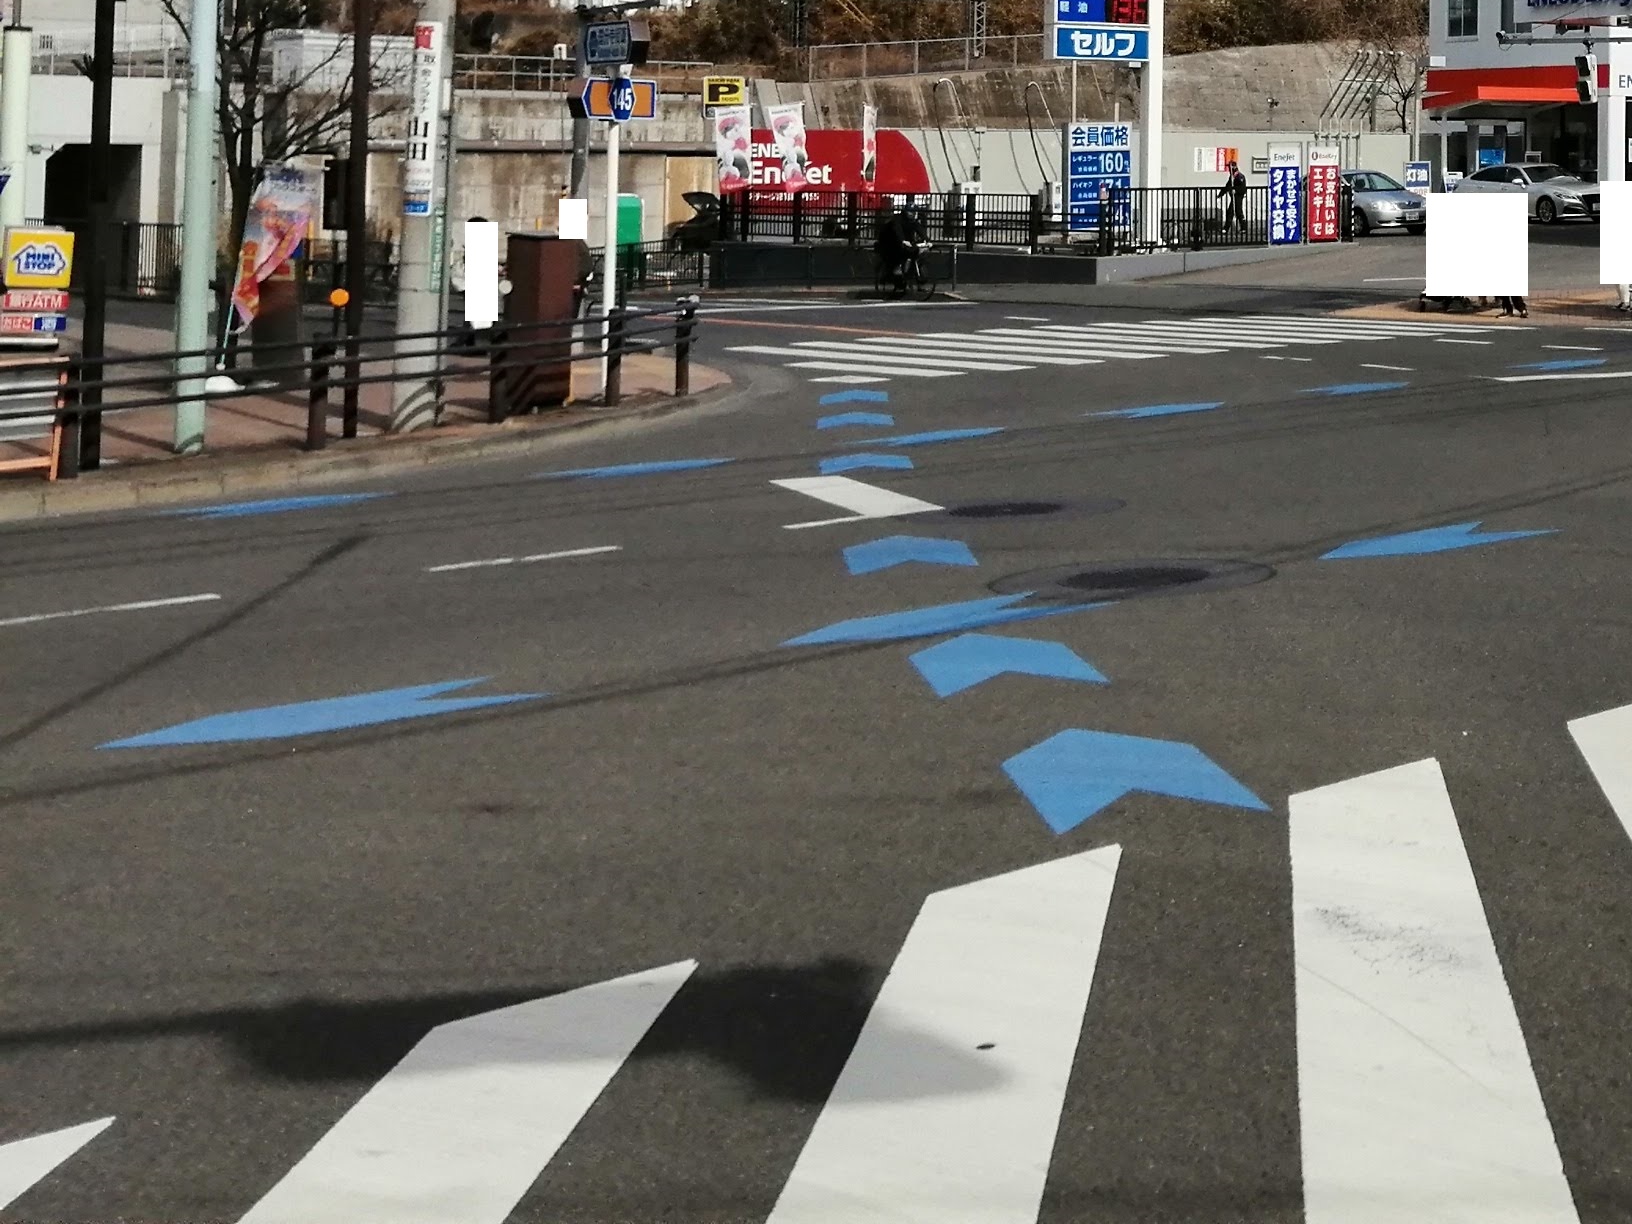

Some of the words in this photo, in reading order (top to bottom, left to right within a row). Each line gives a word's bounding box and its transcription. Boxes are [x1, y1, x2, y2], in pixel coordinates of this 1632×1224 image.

[1070, 30, 1136, 57] セルフ
[612, 88, 632, 111] 145
[707, 83, 740, 102] P
[1071, 126, 1129, 147] 会員価格
[751, 143, 781, 158] ENE
[1099, 153, 1124, 173] 160
[1406, 168, 1428, 182] 灯油
[1272, 169, 1286, 240] タイヤ交換
[1312, 168, 1324, 236] エネキーで
[1324, 168, 1337, 236] お支払いは
[25, 262, 56, 270] STOP
[26, 253, 55, 262] MINI
